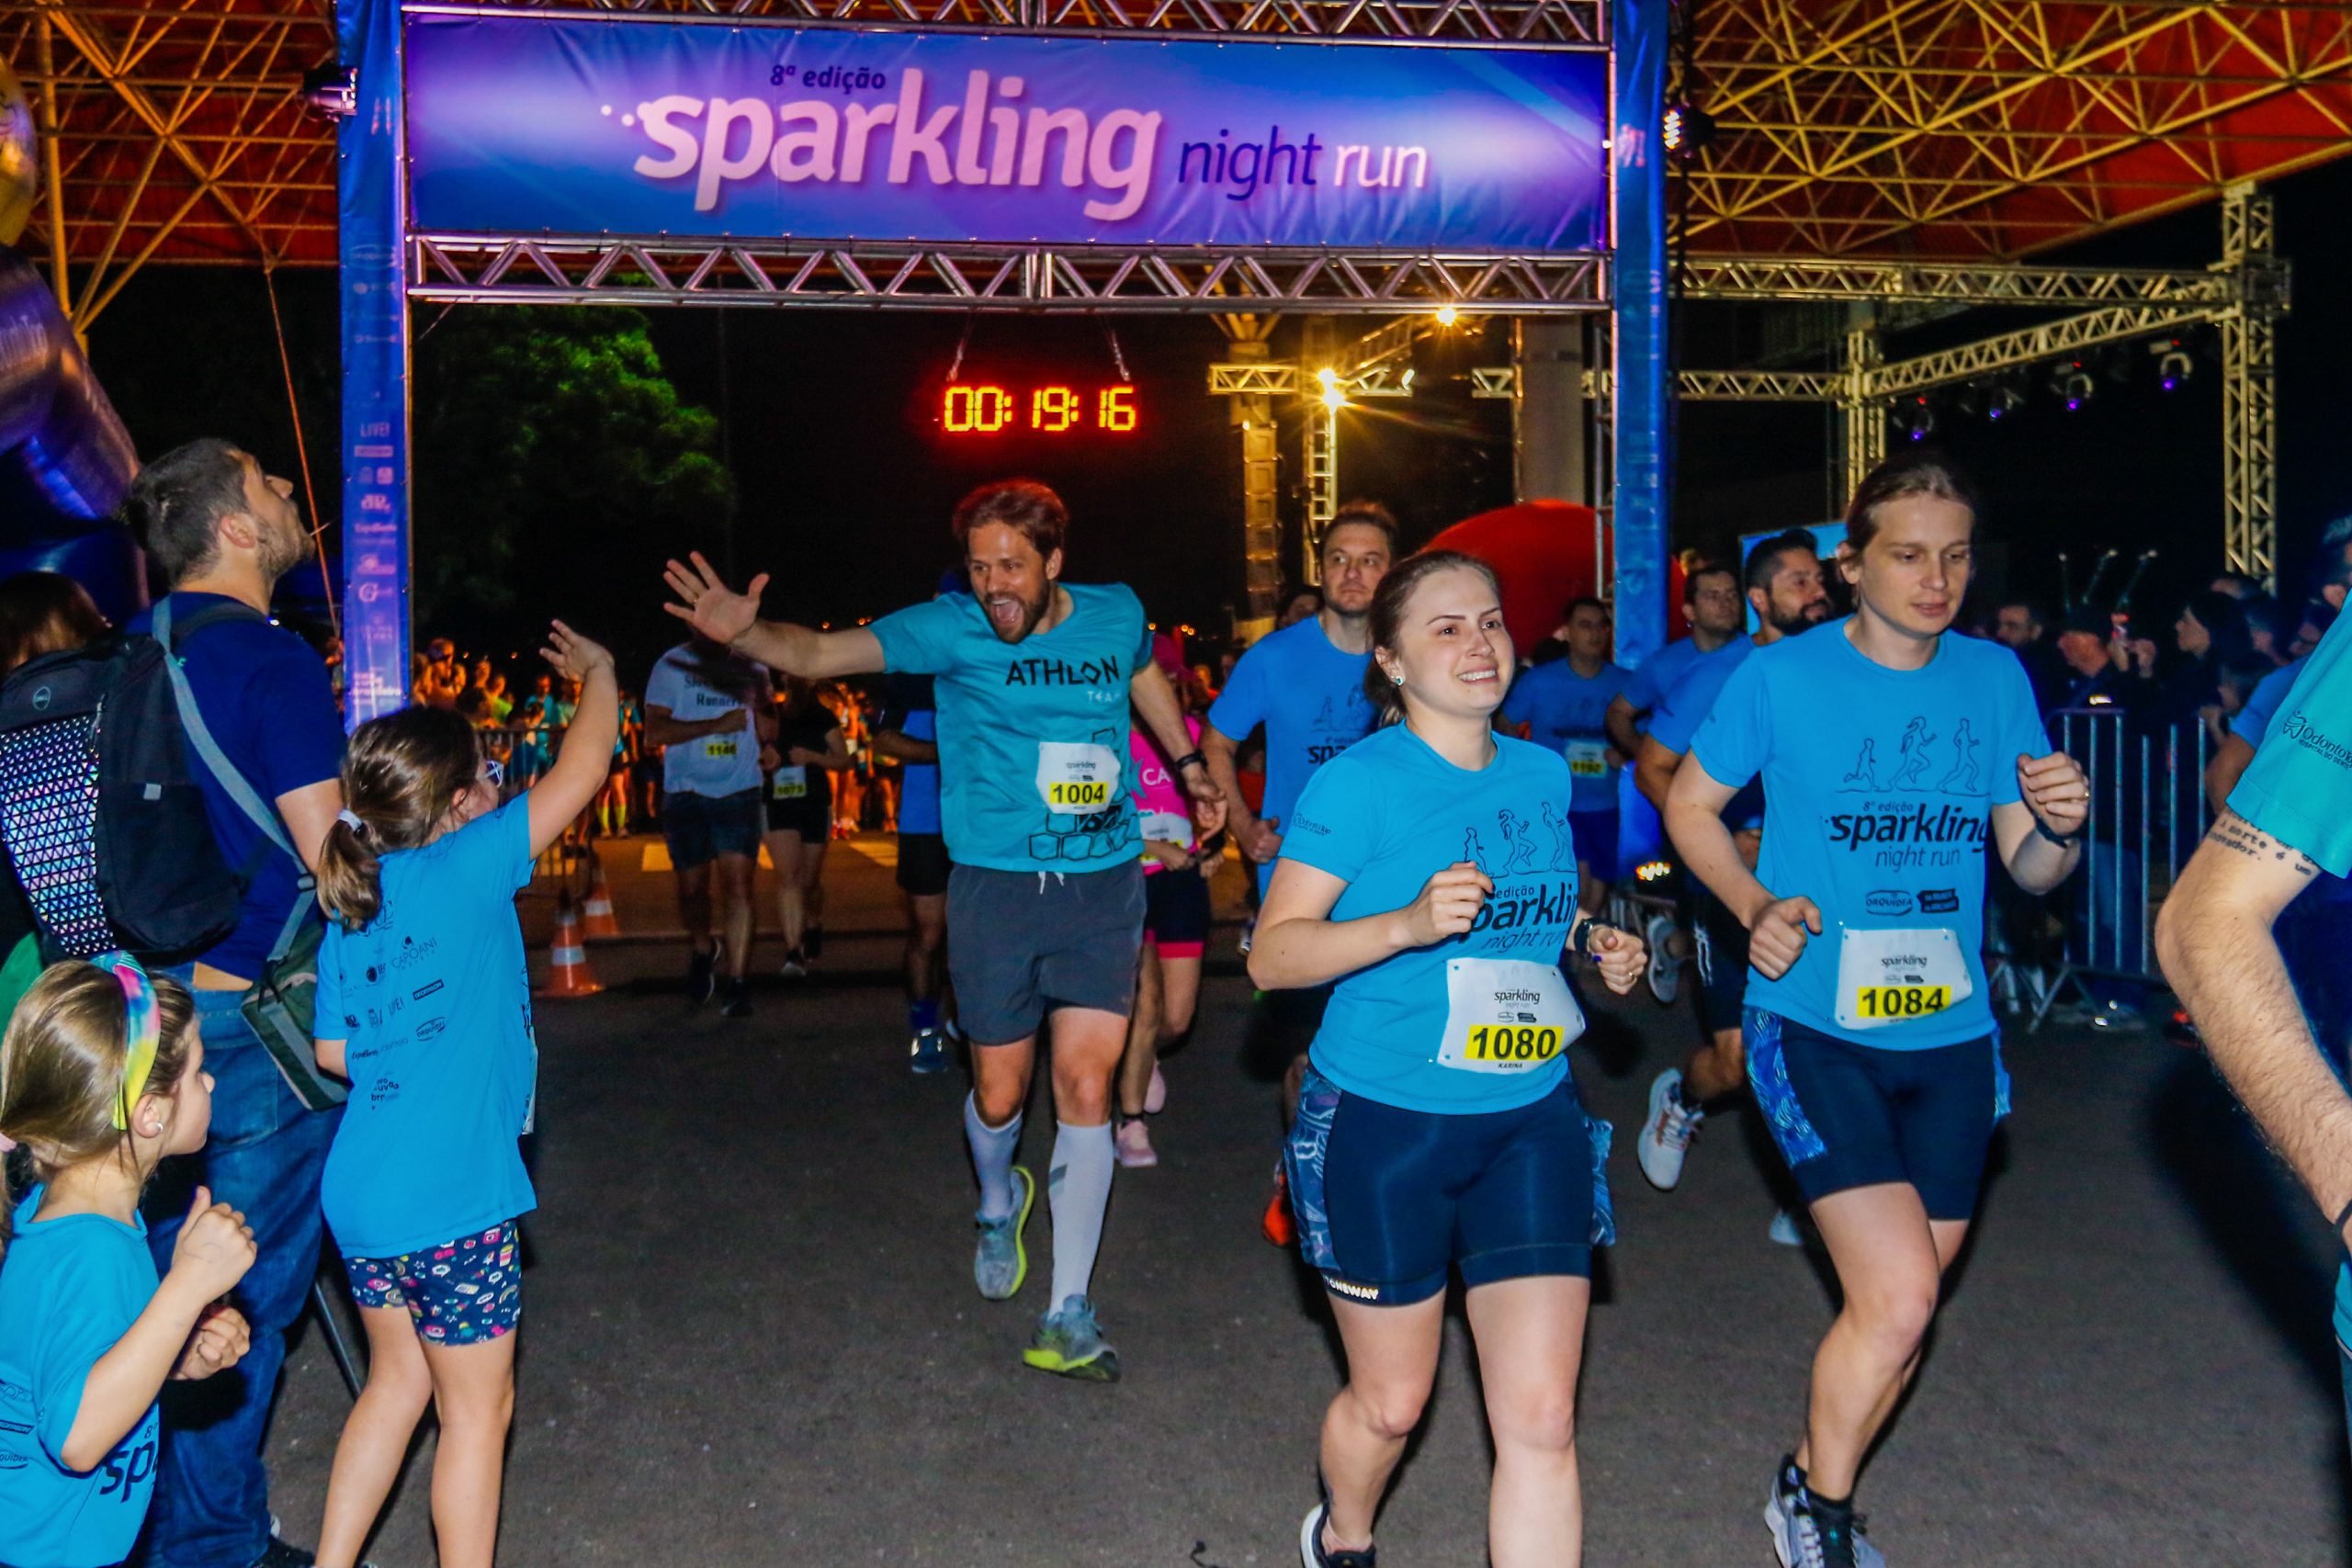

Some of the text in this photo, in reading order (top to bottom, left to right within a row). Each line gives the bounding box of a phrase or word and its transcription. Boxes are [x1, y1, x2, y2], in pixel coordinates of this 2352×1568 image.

[802, 66, 887, 95] edição
[633, 67, 1163, 221] sparkling
[1178, 125, 1428, 201] night run
[1005, 654, 1121, 686] ATHLON
[1052, 784, 1104, 805] 1004
[1875, 845, 1960, 873] night run
[1496, 885, 1535, 899] edição
[1481, 927, 1540, 953] night
[1881, 954, 1928, 968] sparkling
[1494, 988, 1541, 1005] sparkling
[1862, 987, 1944, 1017] 1084
[1473, 1027, 1556, 1060] 1080
